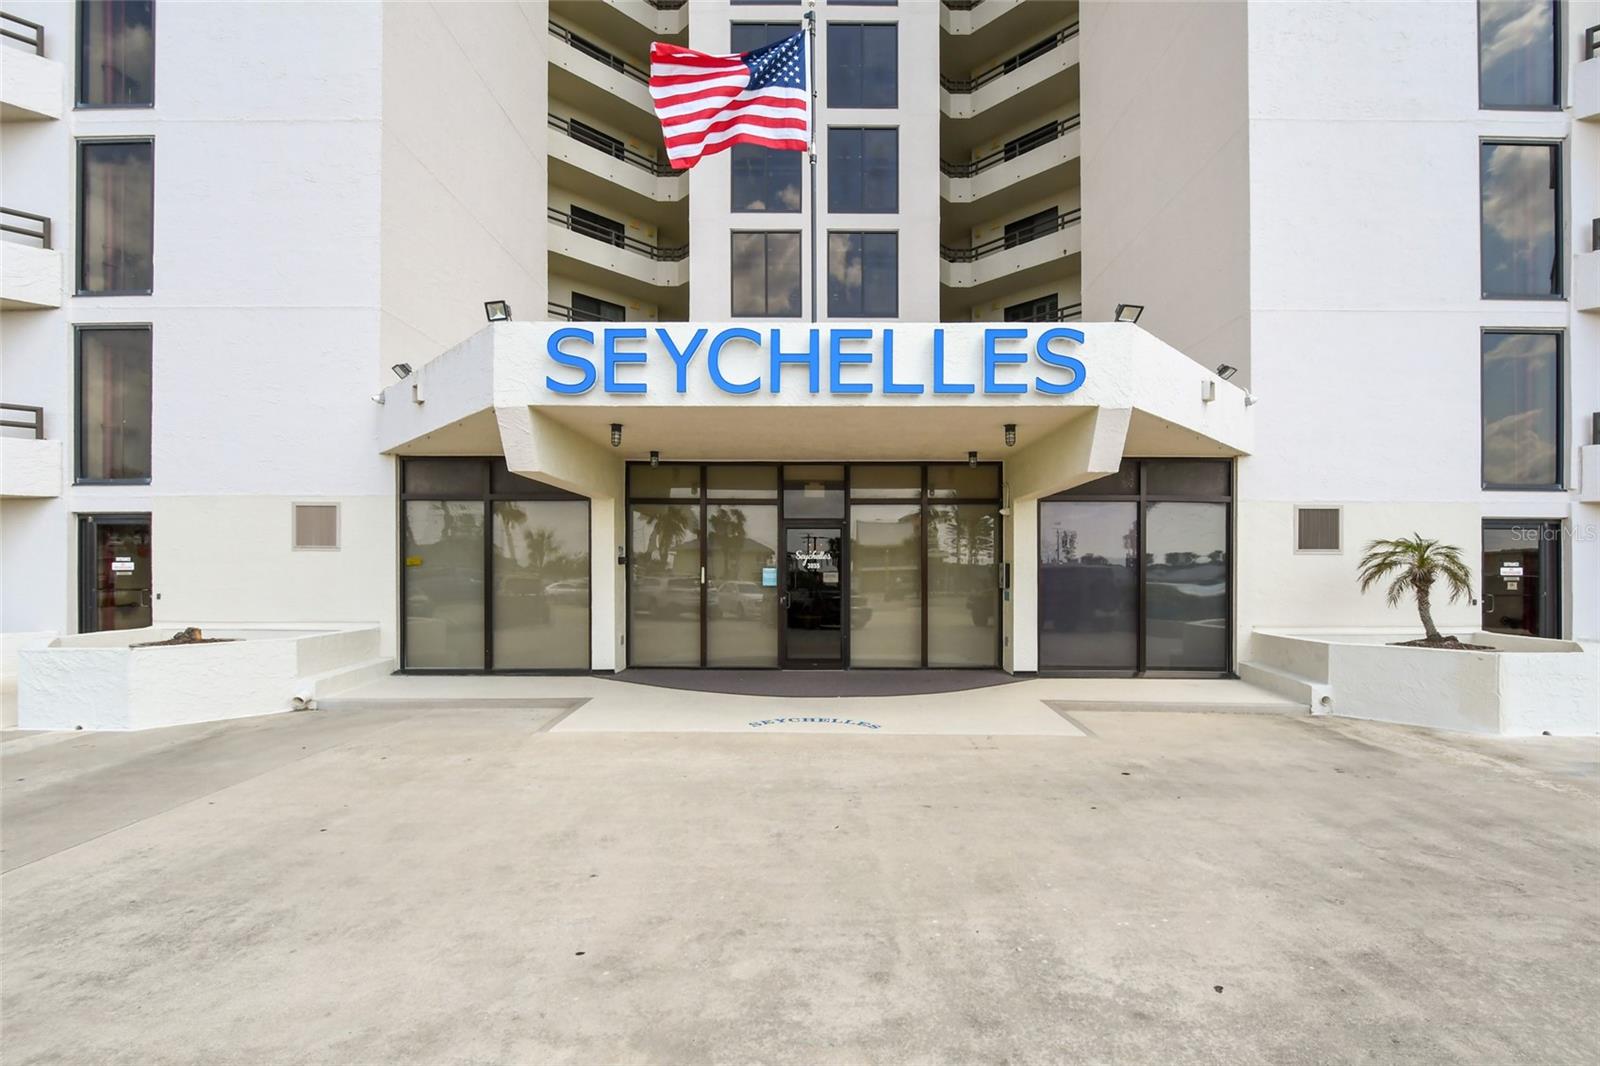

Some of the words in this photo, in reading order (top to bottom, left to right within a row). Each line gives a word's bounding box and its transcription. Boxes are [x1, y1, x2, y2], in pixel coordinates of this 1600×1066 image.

[546, 327, 1086, 395] SEYCHELLES
[795, 550, 831, 567] Seychelles
[748, 717, 881, 729] SEYCHELLES
